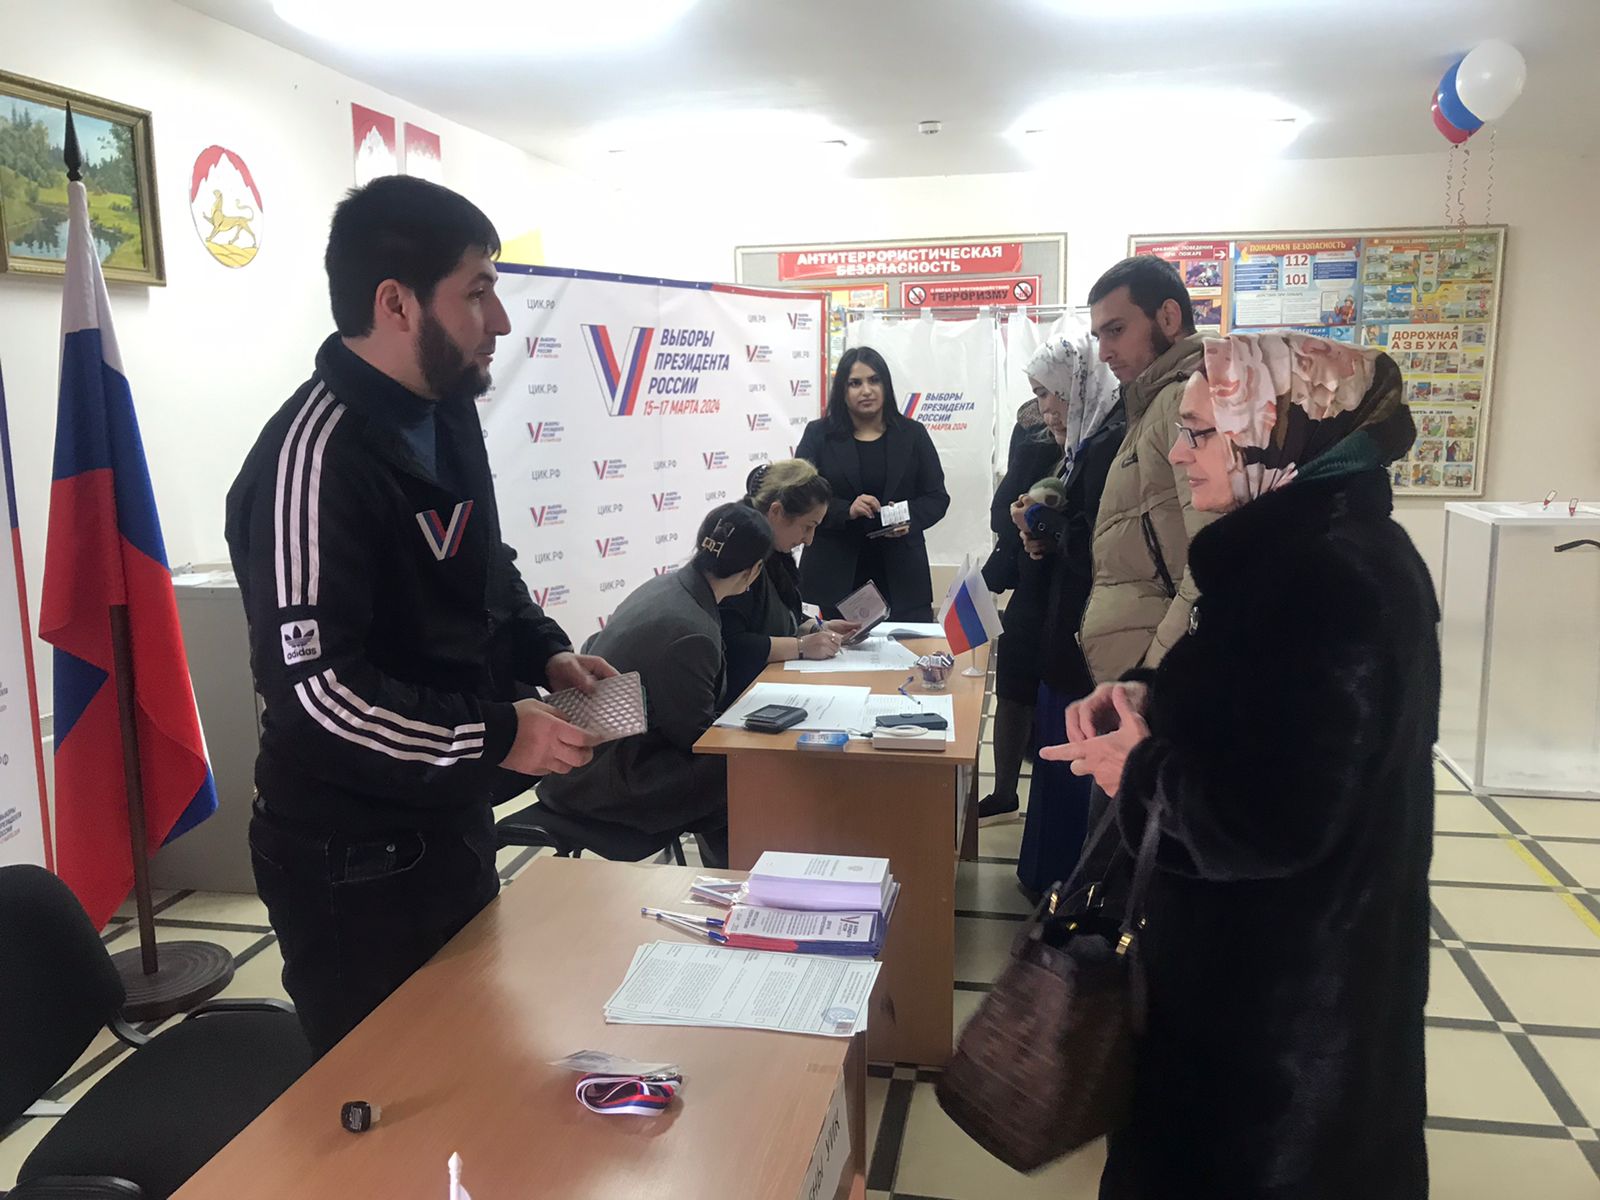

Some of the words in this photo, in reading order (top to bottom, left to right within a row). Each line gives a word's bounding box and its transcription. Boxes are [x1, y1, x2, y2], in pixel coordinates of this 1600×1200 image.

[1249, 243, 1291, 252] ПОЖАРНАЯ
[1292, 241, 1346, 251] БЕЗОПАСНОСТЬ
[797, 246, 1003, 265] АНТИТЕРРОРИСТИЧЕСКАЯ
[1285, 255, 1308, 267] 112
[836, 261, 961, 277] БЕЗОПАСНОСТЬ
[1285, 274, 1308, 286] 101
[930, 290, 1008, 302] ТЕРРОРИЗМУ
[660, 328, 715, 347] ВЫБОРЫ
[1392, 331, 1459, 341] ДОРОЖНАЯ
[1391, 341, 1458, 350] АЗБУКА
[654, 352, 730, 373] ПРЕЗИДЕНТА
[528, 384, 558, 394] ЦИК.РФ
[648, 377, 699, 394] РОССИИ
[925, 392, 964, 401] ВЫБОРЫ
[669, 400, 699, 415] МАРТА
[700, 399, 721, 414] 2024
[921, 402, 975, 412] ПРЕЗИДЕНТА
[917, 413, 952, 422] РОССИИ
[930, 423, 951, 431] МАРТА
[952, 422, 968, 430] 2024
[531, 468, 561, 481] ЦИК.РФ
[597, 503, 623, 515] ЦИК.РФ
[534, 550, 564, 564] ЦИК.РФ
[600, 578, 625, 592] ЦИК.РФ
[287, 647, 317, 660] adidas
